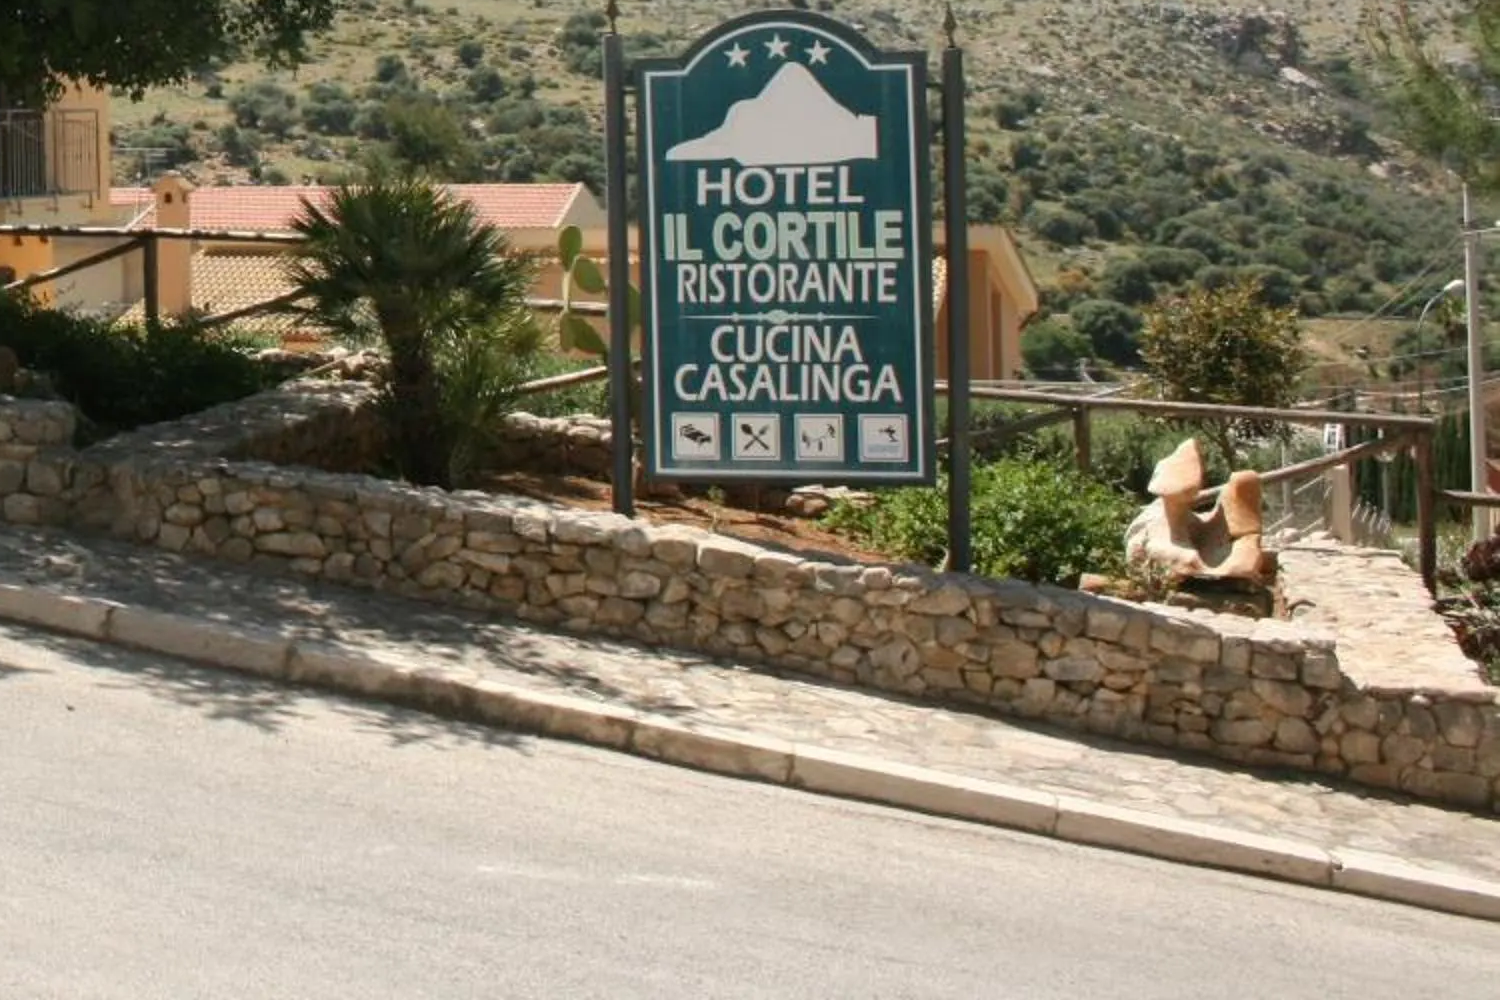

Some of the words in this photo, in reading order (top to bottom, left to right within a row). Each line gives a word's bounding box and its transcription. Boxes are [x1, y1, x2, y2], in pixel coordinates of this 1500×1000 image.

[696, 166, 864, 205] HOTEL
[663, 212, 703, 261] IL
[712, 210, 904, 261] CORTILE
[677, 261, 897, 304] RISTORANTE
[710, 325, 863, 364] CUCINA
[674, 363, 902, 402] CASALINGA
